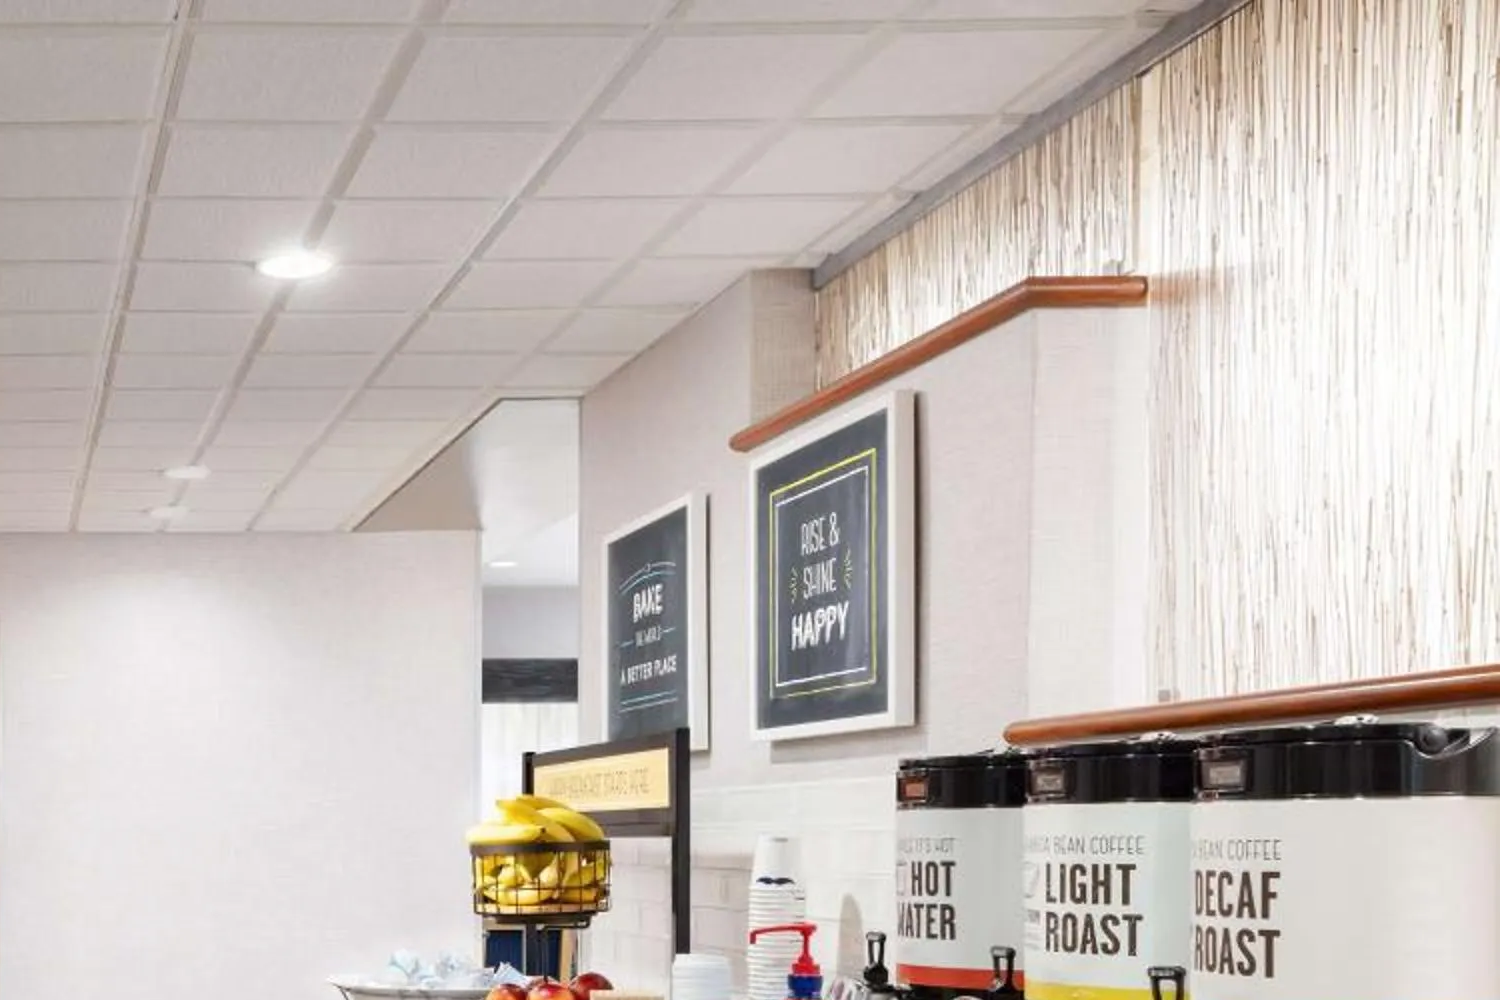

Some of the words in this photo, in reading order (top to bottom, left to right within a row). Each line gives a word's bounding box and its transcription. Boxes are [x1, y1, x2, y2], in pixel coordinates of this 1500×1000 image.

[801, 516, 826, 555] RISE
[829, 511, 840, 546] &
[803, 557, 837, 600] SHINE
[633, 583, 663, 622] BAKE
[791, 600, 849, 650] HAPPY
[627, 661, 653, 684] BETTER
[654, 654, 677, 676] PLACE
[1053, 835, 1085, 855] BEAN
[1090, 835, 1145, 855] COFFEE
[1227, 839, 1282, 861] COFFEE
[911, 860, 956, 897] HOT
[1045, 863, 1137, 906] LIGHT
[1195, 869, 1281, 920] DECAF
[1045, 911, 1144, 957] ROAST
[1194, 924, 1281, 979] ROAST
